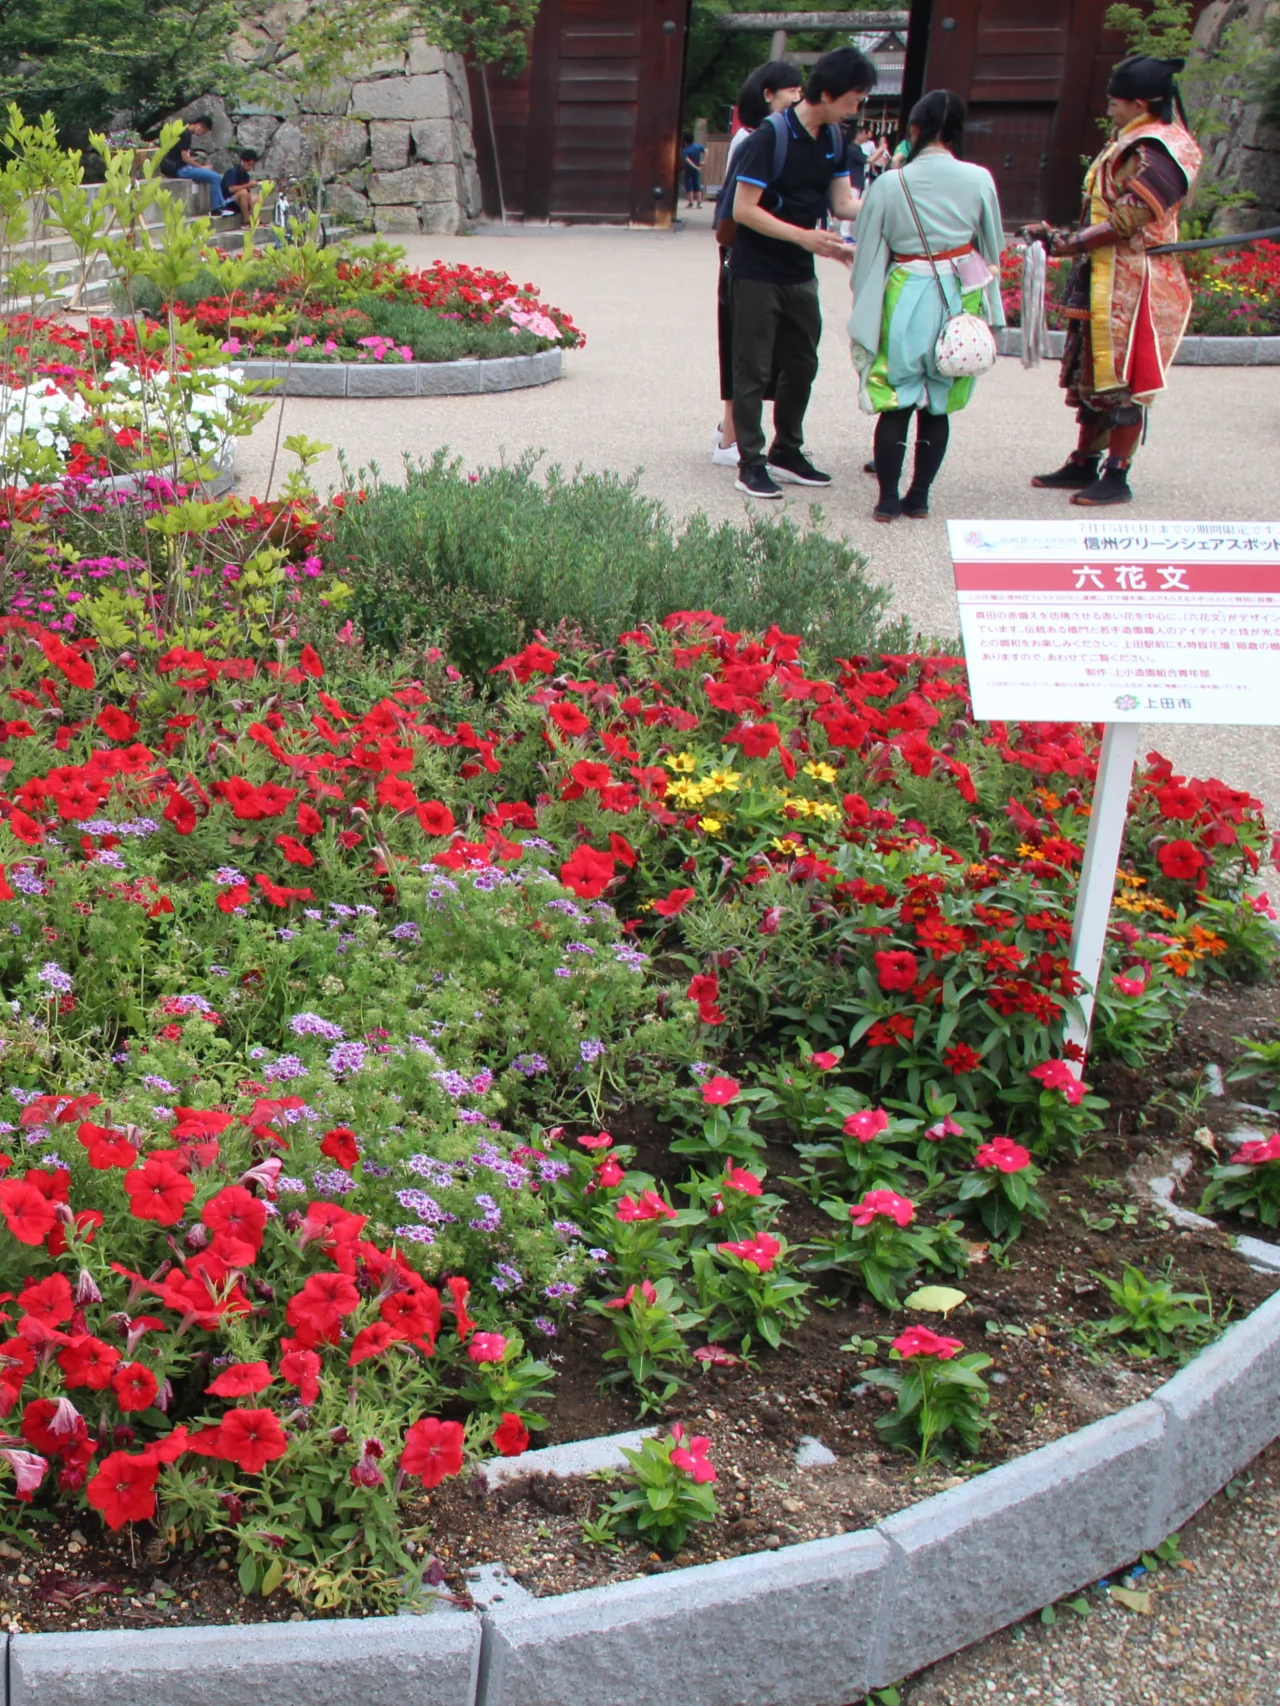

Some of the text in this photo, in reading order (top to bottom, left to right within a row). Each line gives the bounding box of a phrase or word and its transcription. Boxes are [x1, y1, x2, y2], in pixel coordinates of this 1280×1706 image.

[1083, 536, 1280, 551] 信州グリーンシェアスポット
[1072, 565, 1190, 590] 六花文
[1144, 697, 1192, 710] 上田市
